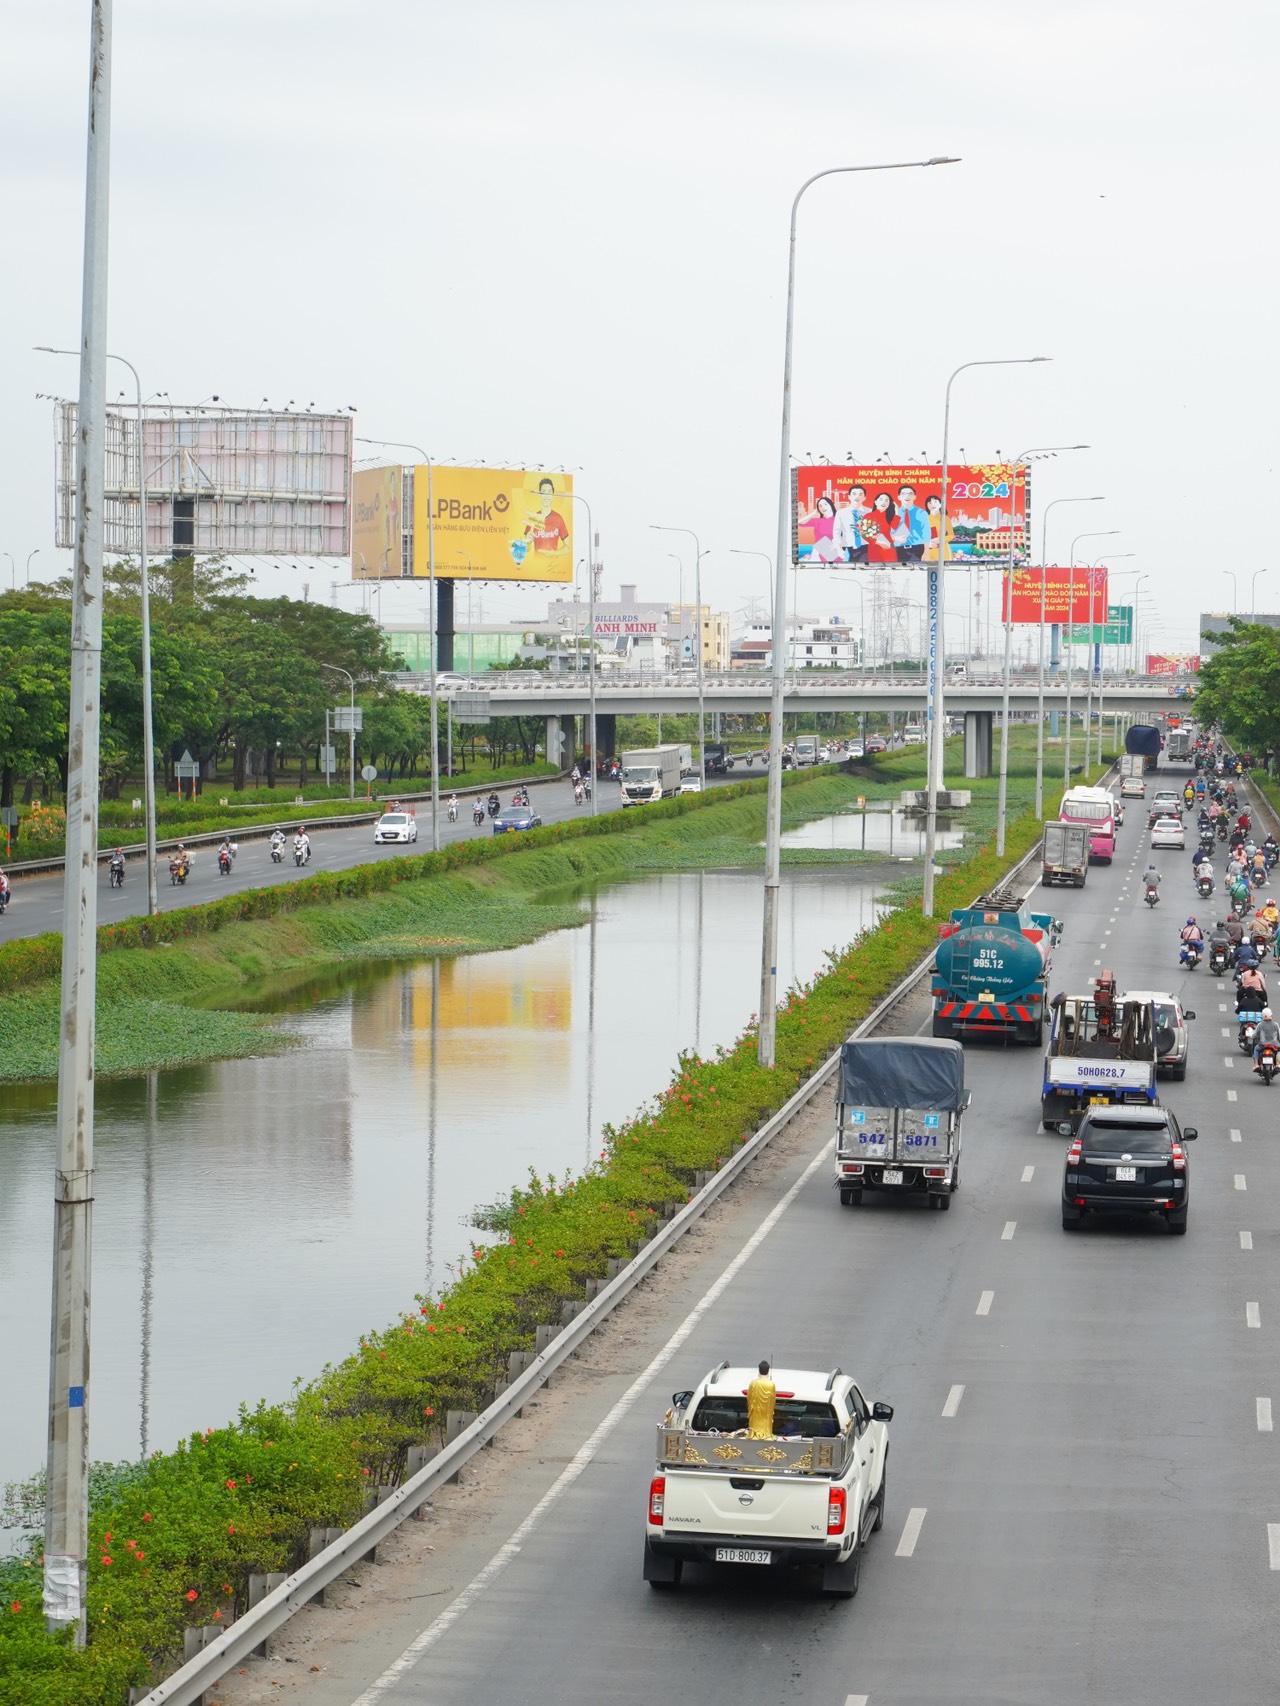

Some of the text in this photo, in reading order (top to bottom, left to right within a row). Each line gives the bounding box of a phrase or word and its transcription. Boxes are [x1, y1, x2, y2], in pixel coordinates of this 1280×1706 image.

[858, 469, 883, 477] HUYỆN
[952, 482, 1010, 498] 2024
[427, 498, 492, 520] LPBank
[593, 623, 657, 632] ANH MINH
[980, 949, 997, 958] 51C
[973, 959, 1003, 968] 995.12
[859, 1133, 885, 1144] 54Z
[906, 1135, 937, 1146] 5871
